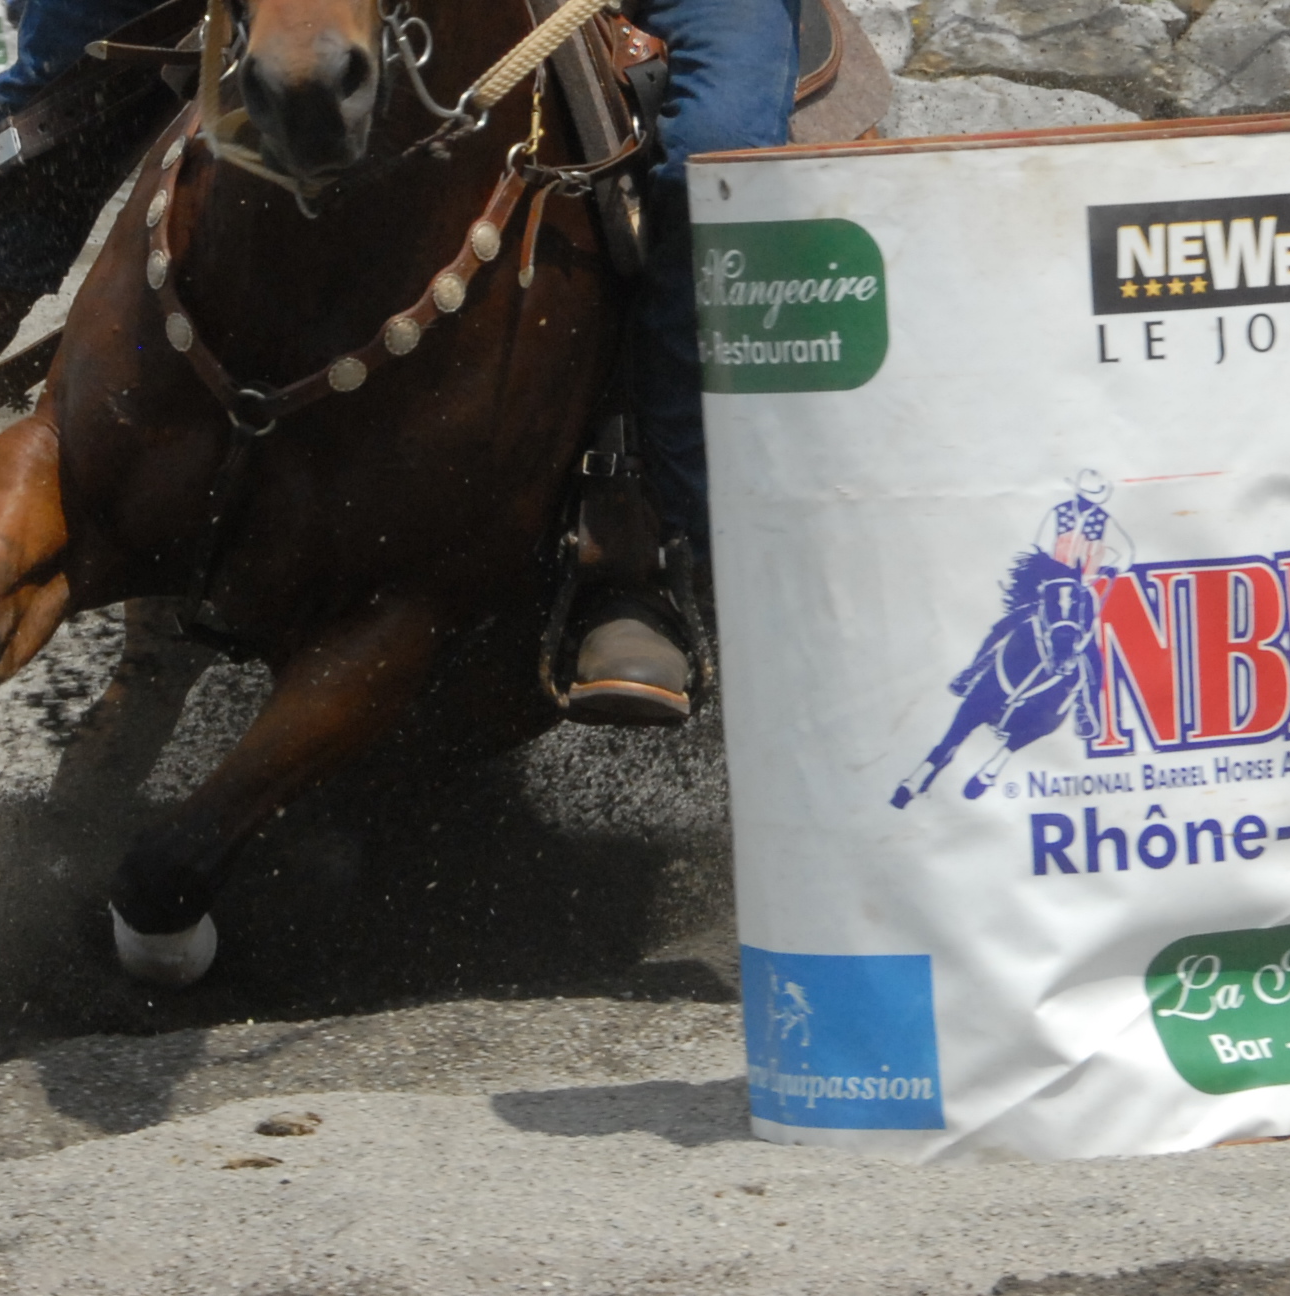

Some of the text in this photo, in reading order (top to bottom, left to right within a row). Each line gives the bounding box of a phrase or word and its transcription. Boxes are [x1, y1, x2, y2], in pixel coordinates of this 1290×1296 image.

[1097, 320, 1167, 364] LE
[1156, 955, 1246, 1021] La
[1209, 1034, 1274, 1064] Bar
